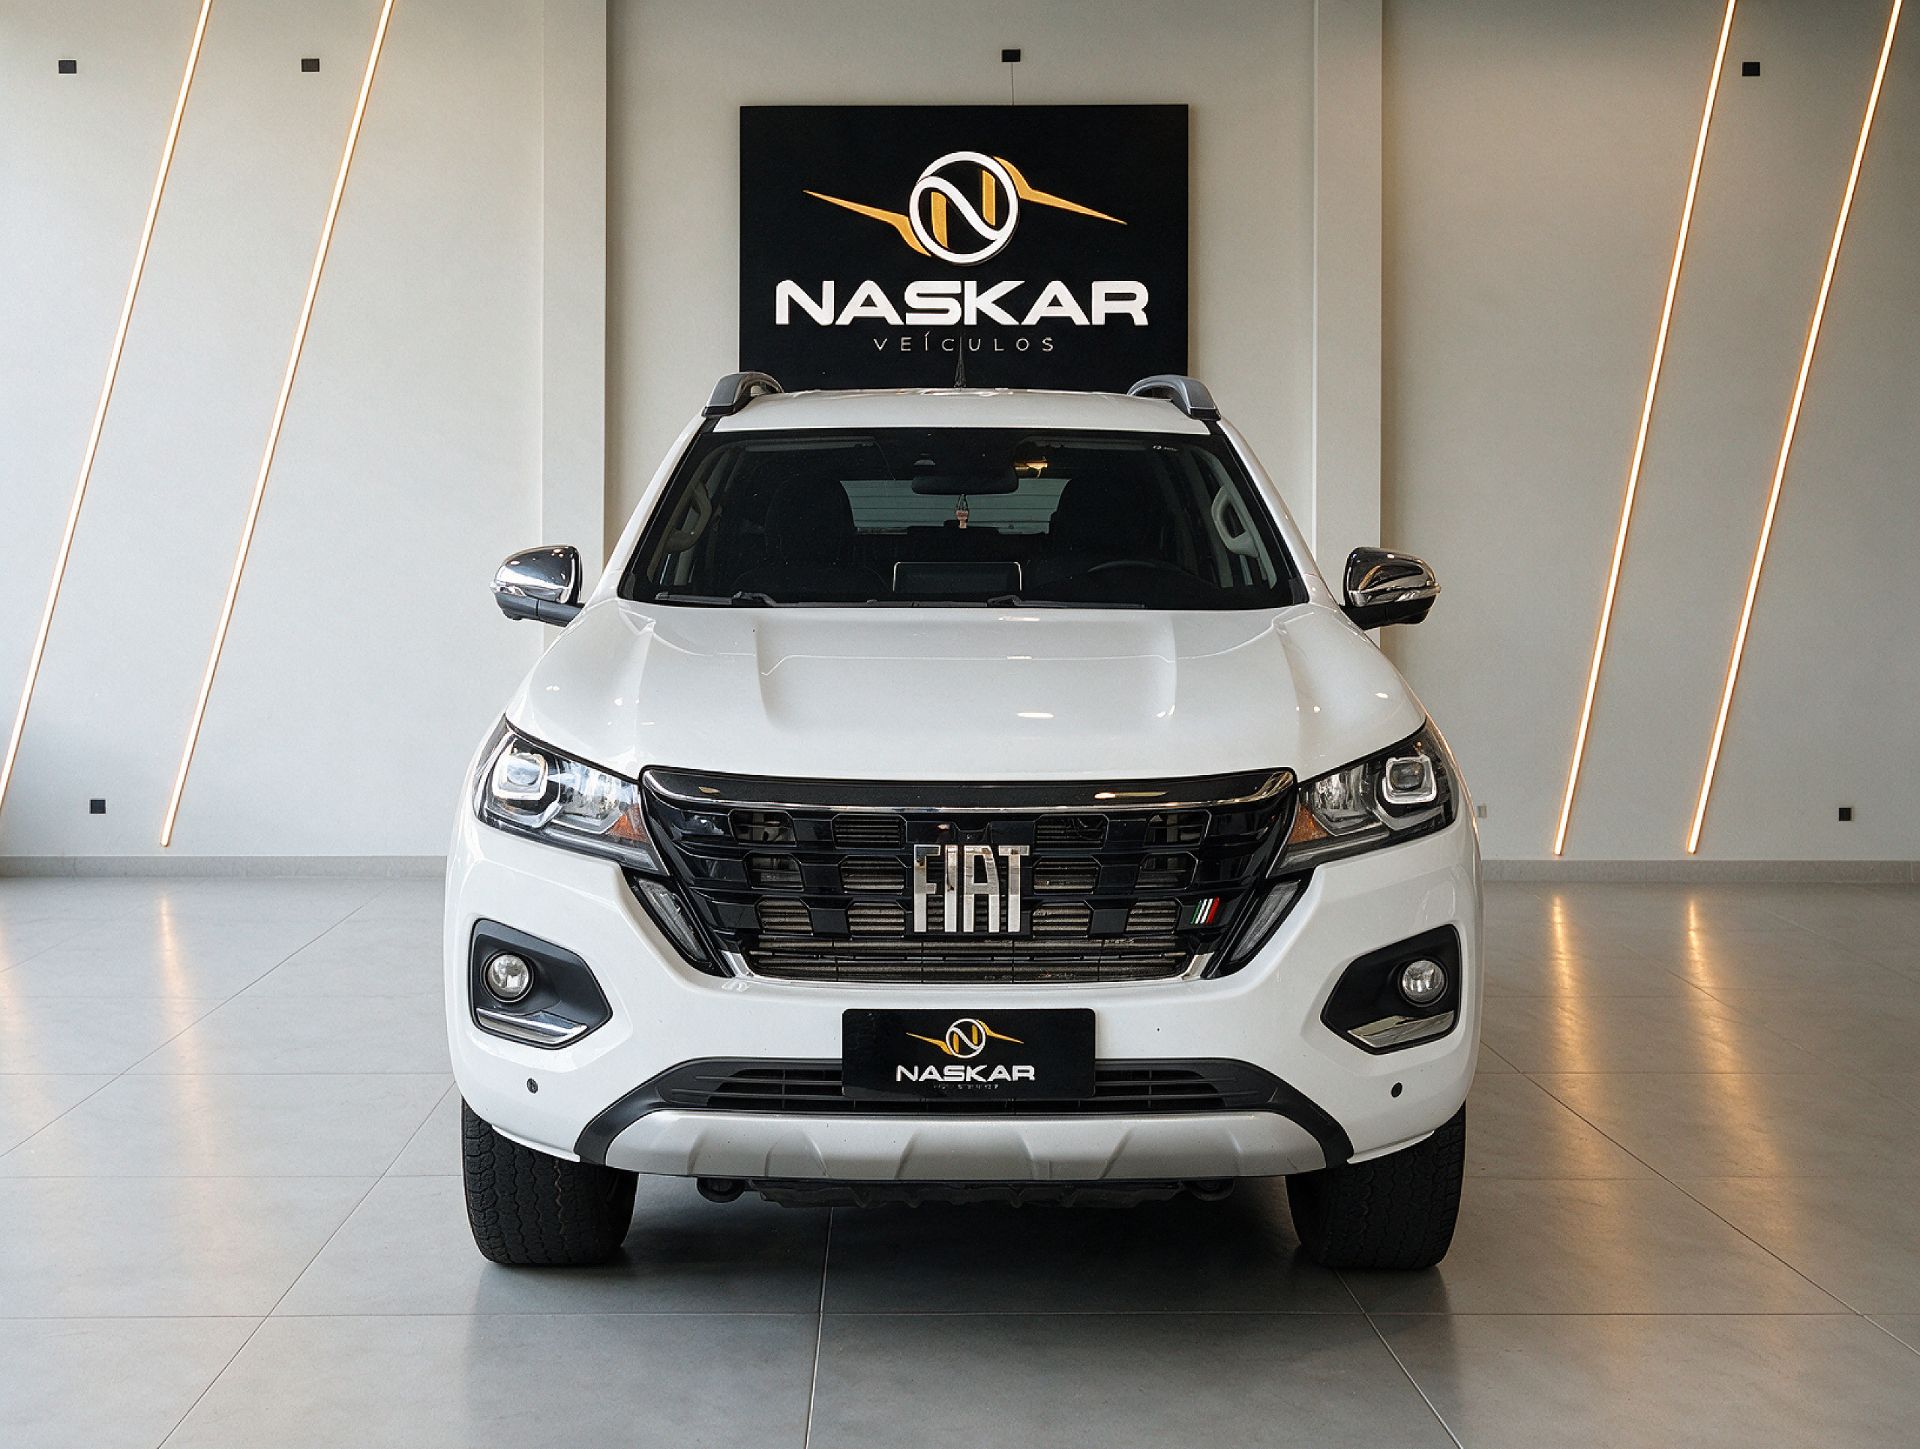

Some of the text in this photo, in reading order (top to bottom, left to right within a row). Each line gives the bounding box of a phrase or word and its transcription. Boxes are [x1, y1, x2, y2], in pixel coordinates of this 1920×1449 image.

[775, 280, 1149, 326] NASKAR
[873, 331, 1054, 351] VEÍCULOS
[913, 844, 1030, 933] FIAT
[896, 1065, 1035, 1082] NASKAR
